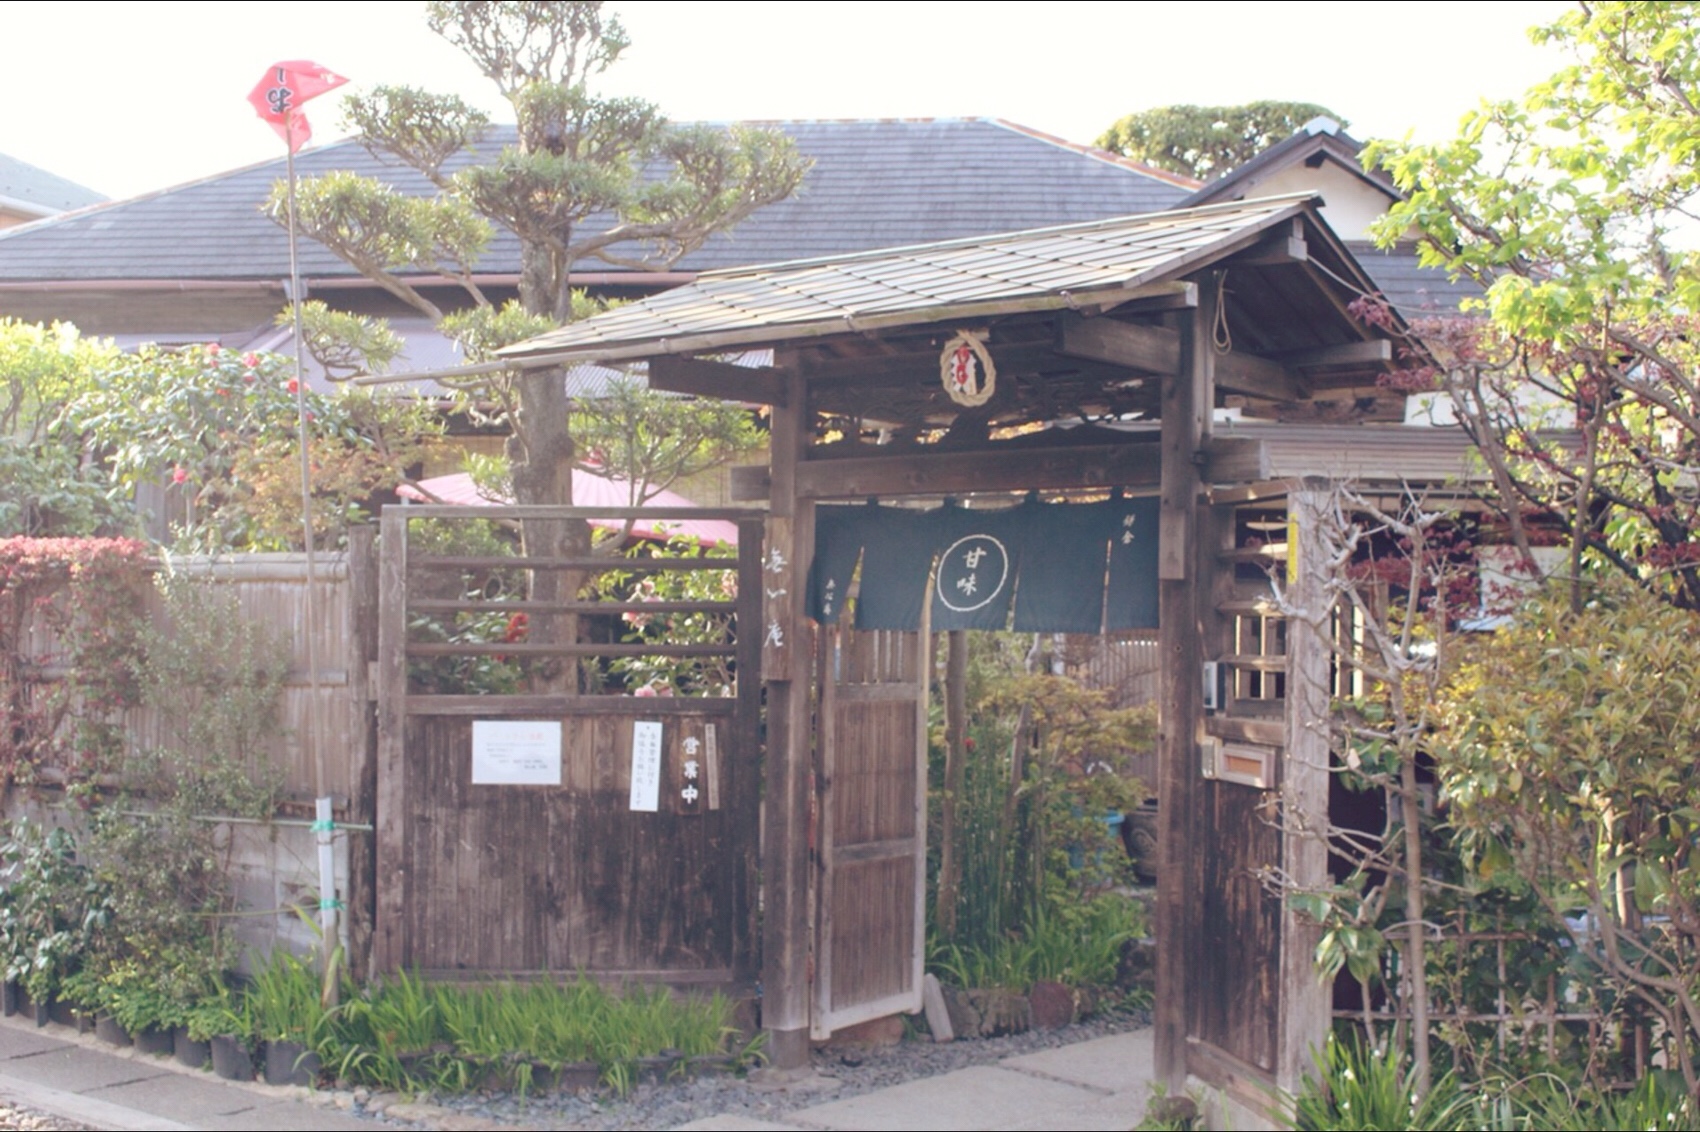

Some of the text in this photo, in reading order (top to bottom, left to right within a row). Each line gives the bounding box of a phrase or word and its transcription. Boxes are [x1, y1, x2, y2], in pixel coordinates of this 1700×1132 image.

[956, 546, 987, 596] 甘味
[681, 736, 700, 804] 営業中
